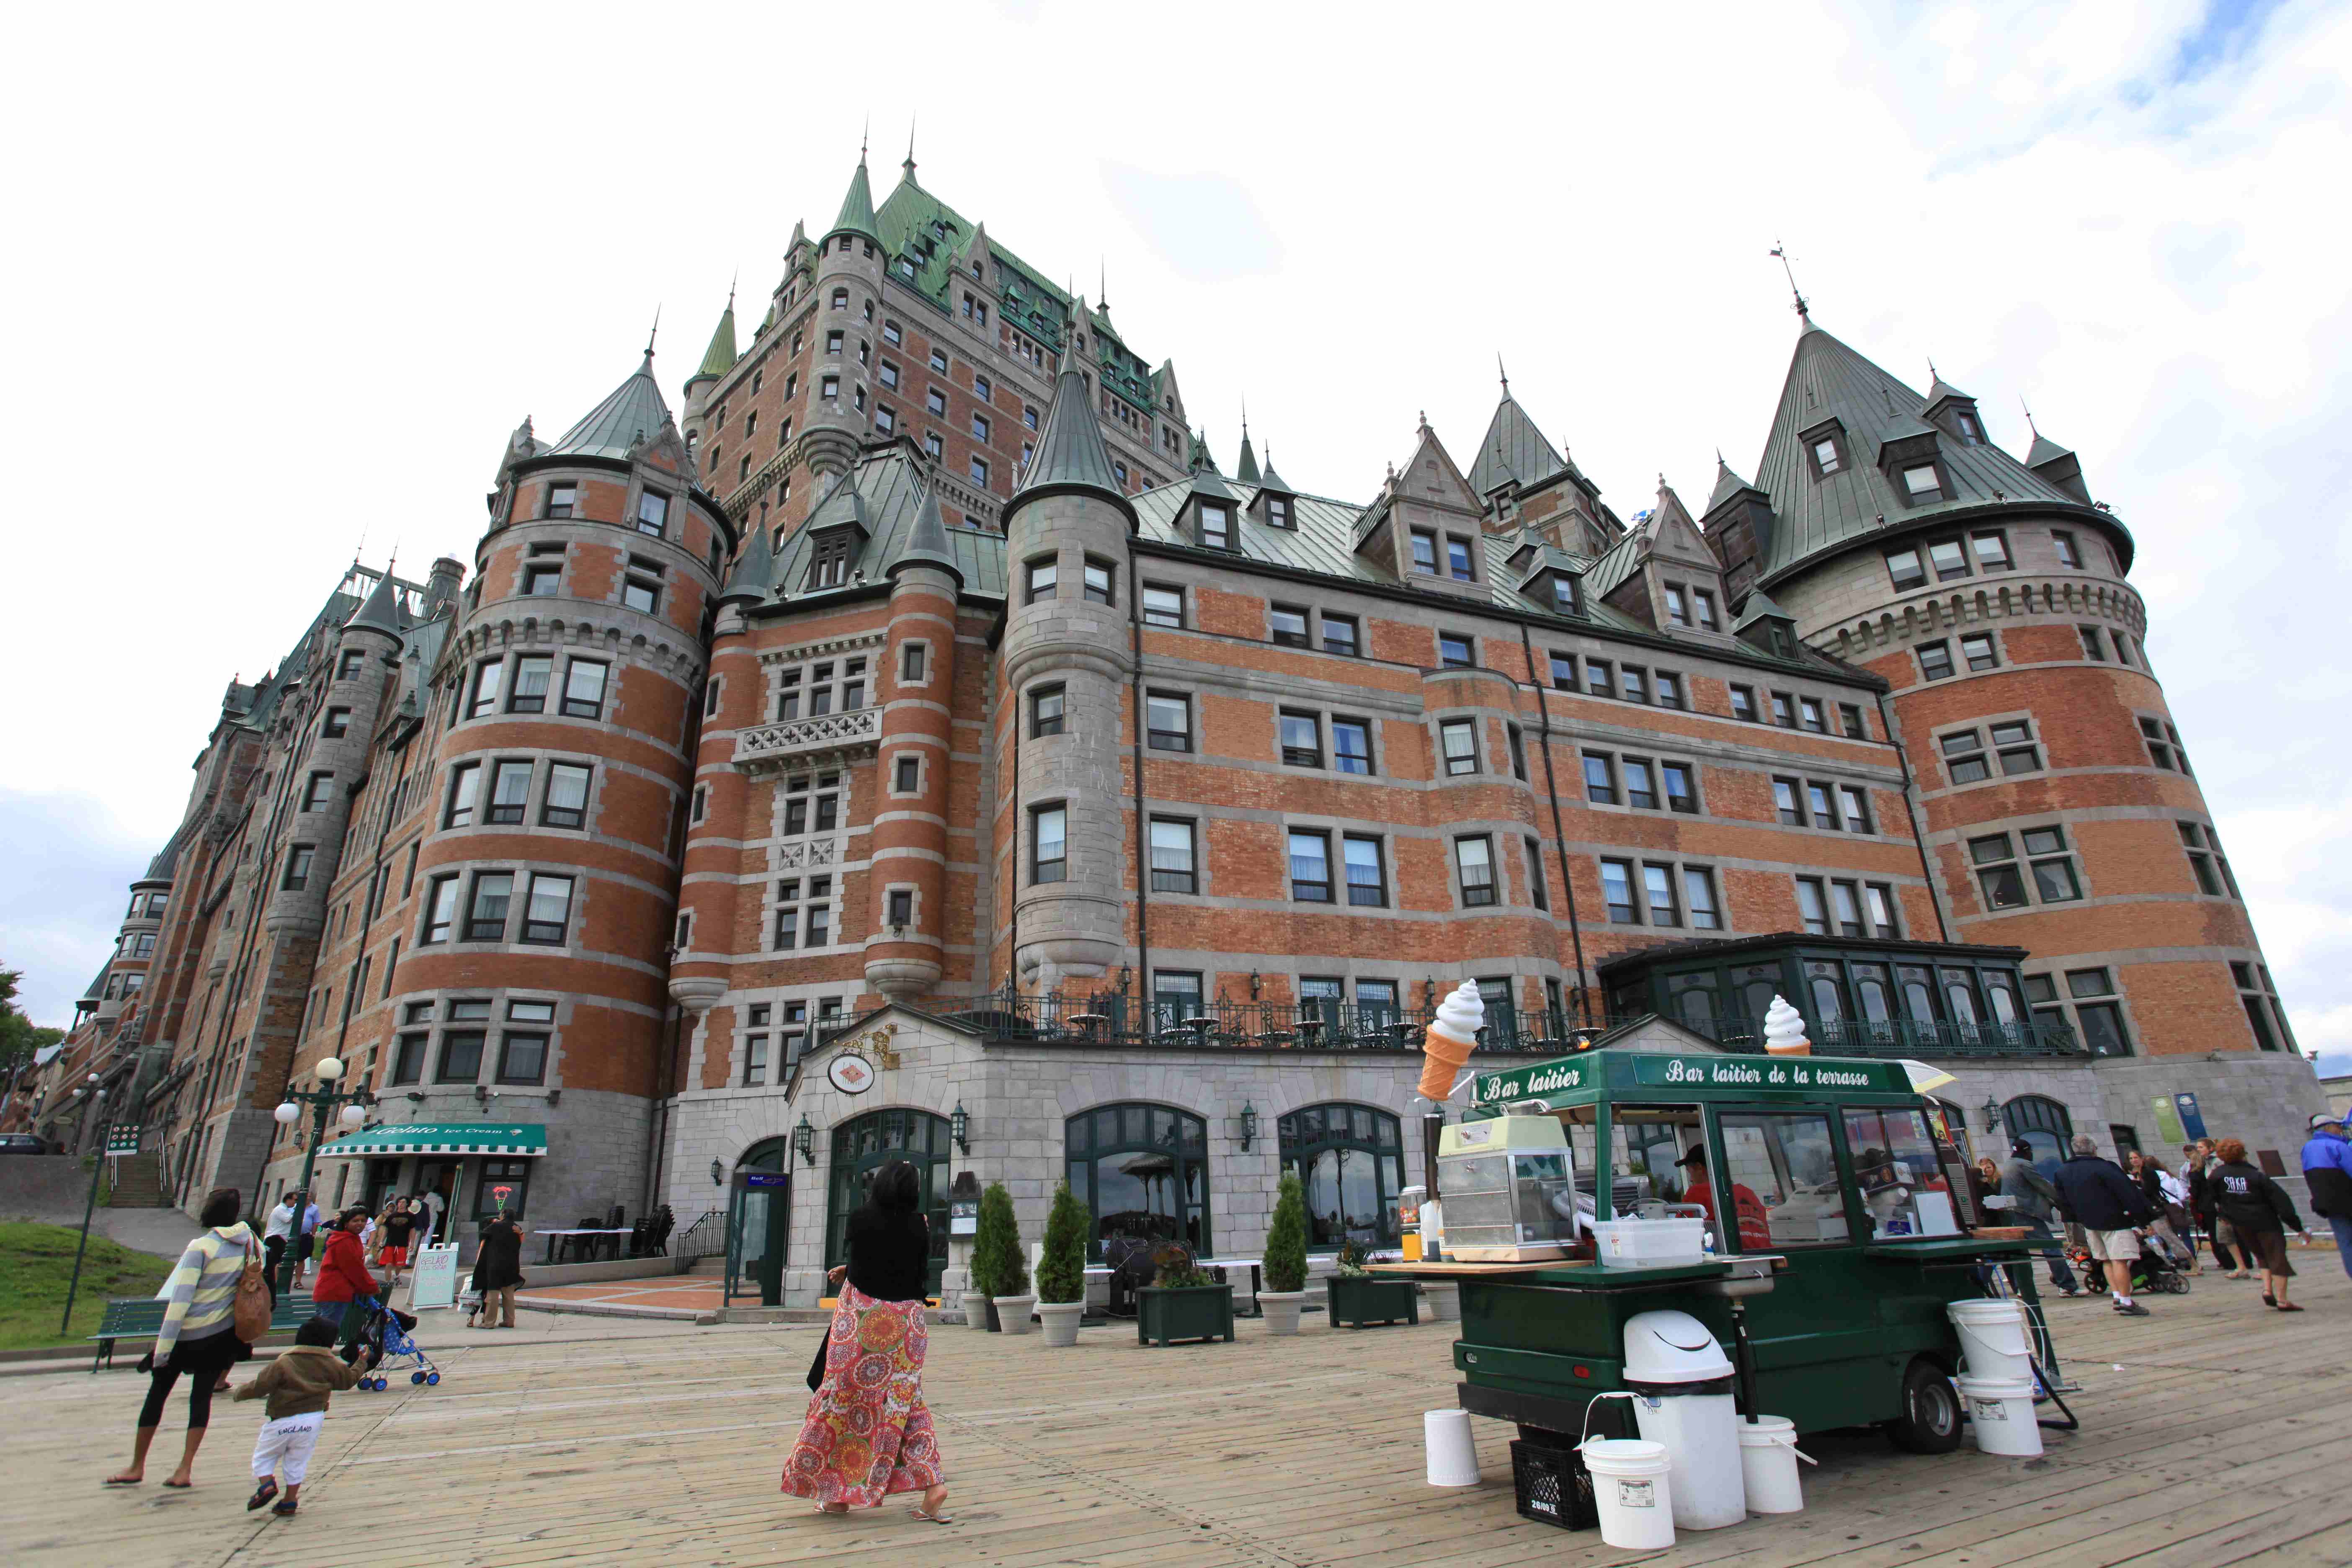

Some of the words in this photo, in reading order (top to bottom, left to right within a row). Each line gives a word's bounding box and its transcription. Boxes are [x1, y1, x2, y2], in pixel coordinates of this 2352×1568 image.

[1666, 1059, 1704, 1082] Bar
[1712, 1063, 1761, 1082] laitier
[1769, 1064, 1786, 1083] de
[1793, 1065, 1809, 1084] la
[1816, 1068, 1869, 1086] terrasse
[1484, 1076, 1519, 1101] Bar
[1527, 1066, 1580, 1093] laitier
[376, 1126, 438, 1135] Gelato
[2224, 1176, 2246, 1191] SAKA
[420, 1254, 449, 1265] GELATO
[278, 1425, 312, 1435] ENGLAND
[1531, 1499, 1550, 1512] 26/09
